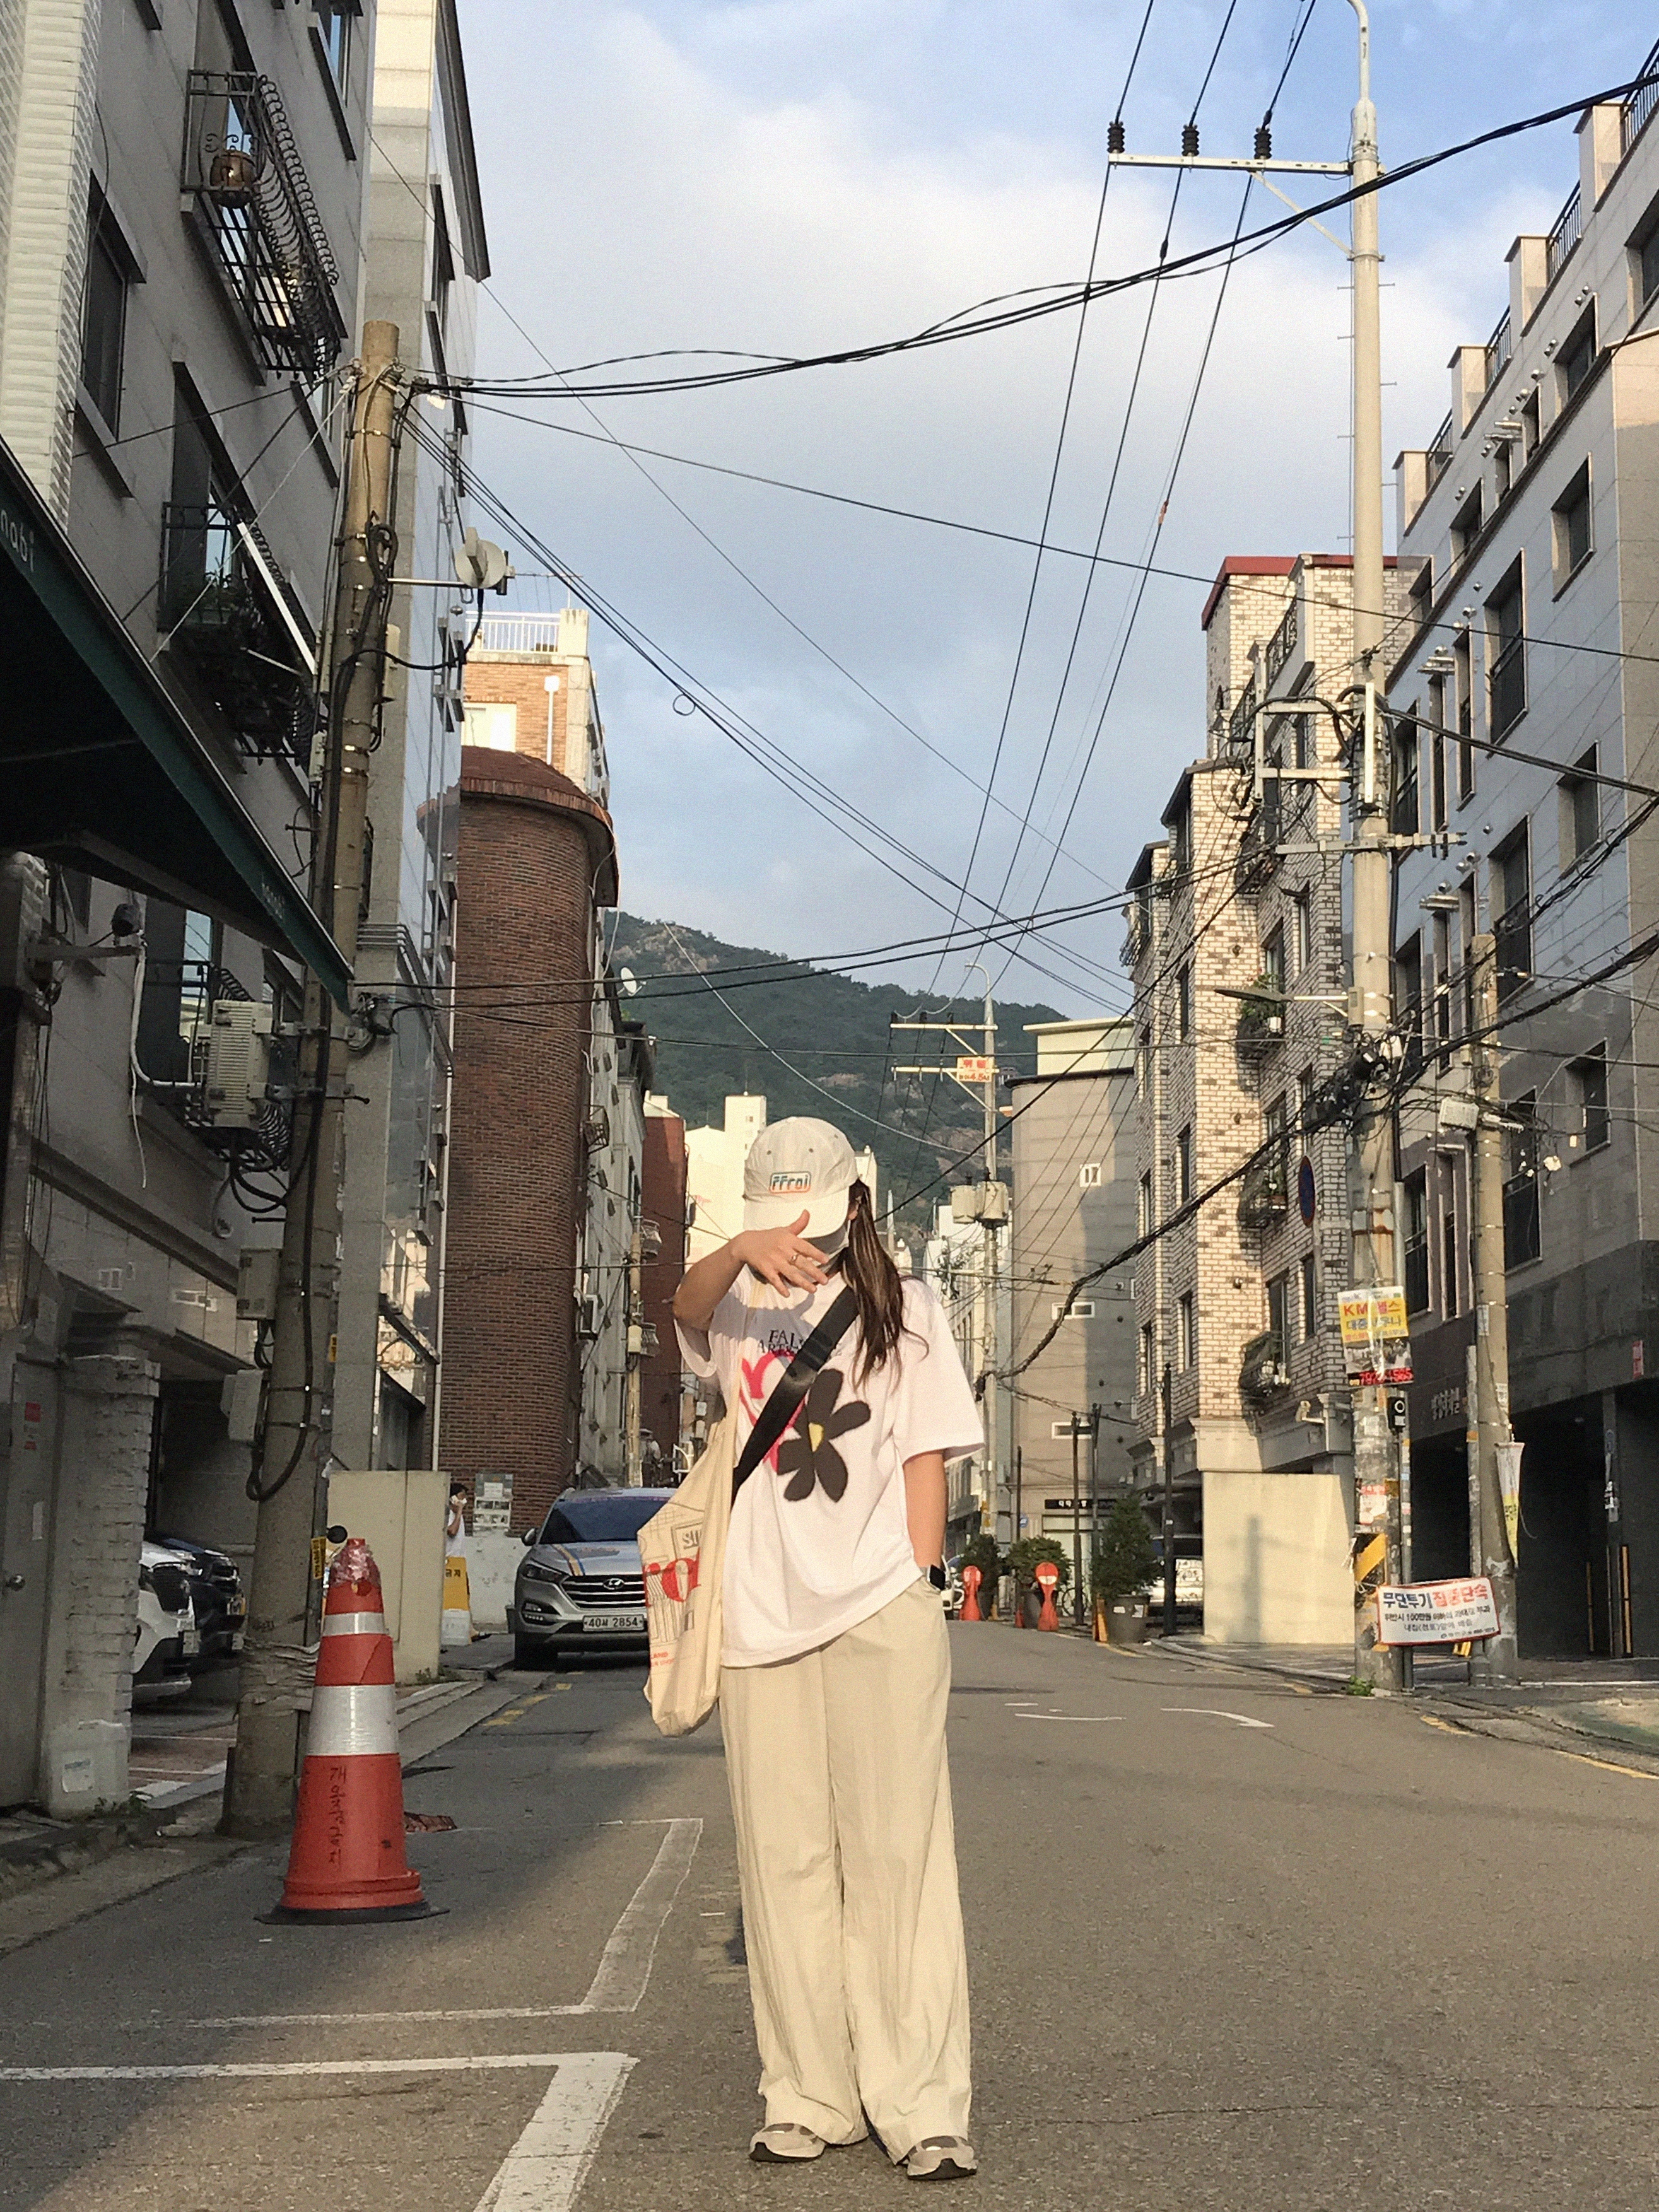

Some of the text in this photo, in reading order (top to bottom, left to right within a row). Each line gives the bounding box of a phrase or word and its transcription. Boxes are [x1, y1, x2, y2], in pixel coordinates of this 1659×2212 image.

[769, 1329, 805, 1350] FAL
[1383, 1583, 1489, 1609] 무단투기 집중단속
[612, 1616, 638, 1628] 2854
